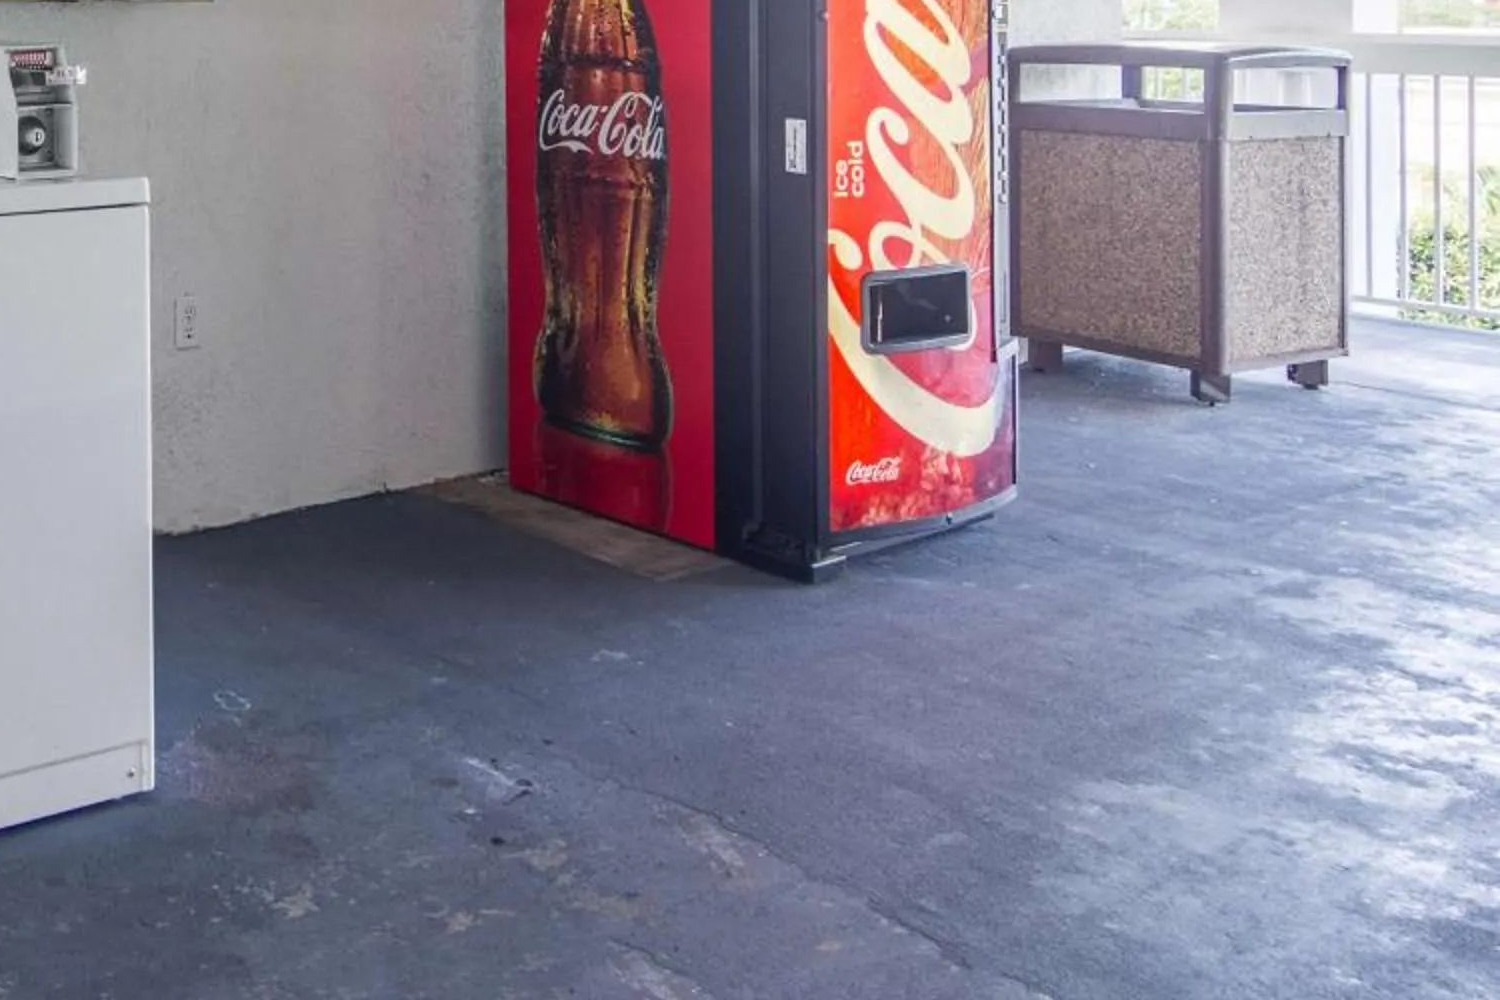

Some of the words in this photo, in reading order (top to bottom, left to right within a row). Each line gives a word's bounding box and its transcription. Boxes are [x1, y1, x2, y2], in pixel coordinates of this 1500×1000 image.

[539, 87, 665, 160] Coca-Cola
[834, 159, 849, 198] ice
[847, 140, 865, 199] cold
